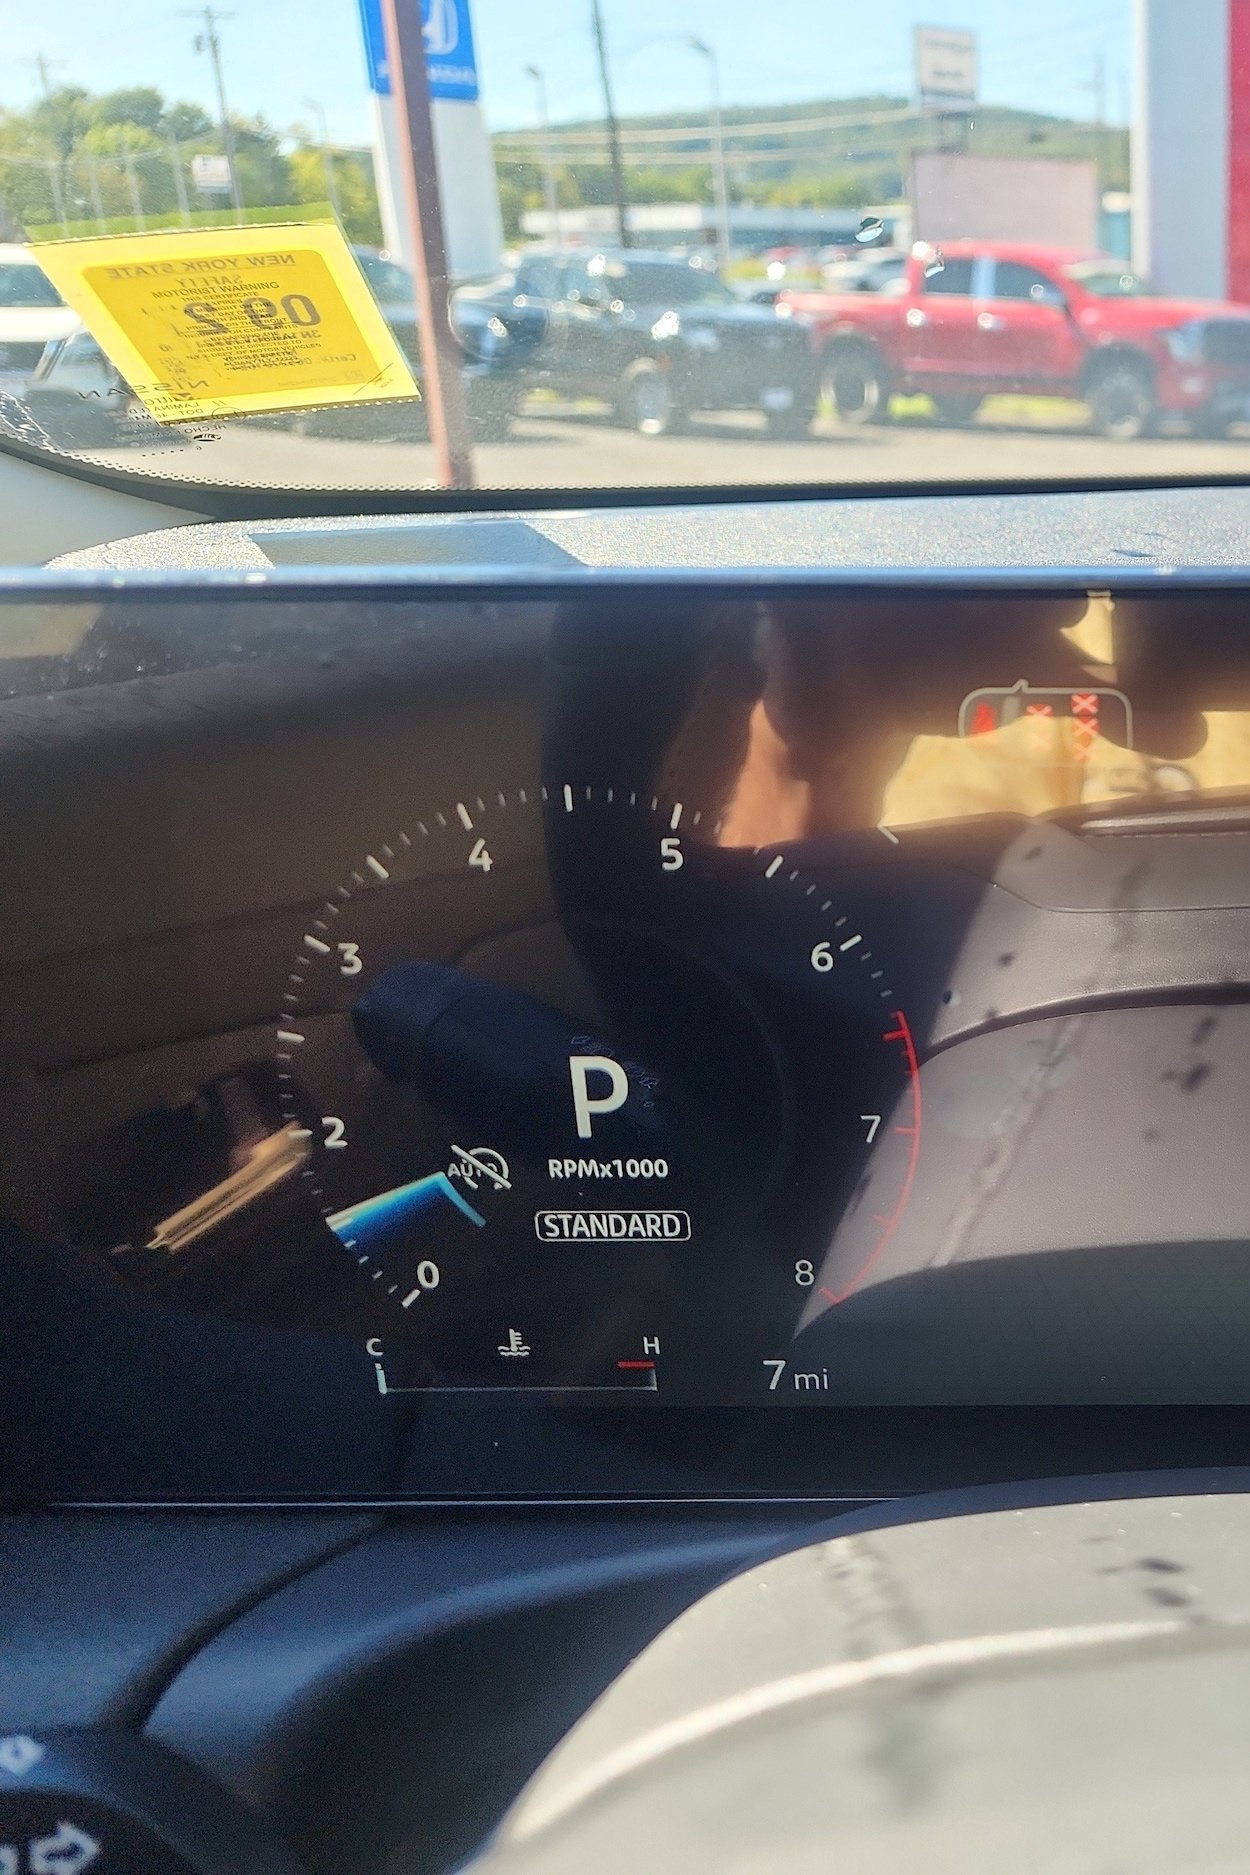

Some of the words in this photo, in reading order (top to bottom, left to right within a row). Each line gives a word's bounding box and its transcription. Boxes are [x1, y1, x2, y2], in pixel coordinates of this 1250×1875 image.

[151, 286, 218, 299] MOTORIST
[220, 281, 280, 293] WARNING
[468, 838, 493, 872] 4
[660, 838, 684, 871] 5
[337, 942, 363, 976] 3
[810, 941, 834, 973] 6
[569, 1055, 629, 1139] P
[321, 1116, 348, 1149] 2
[860, 1114, 882, 1144] 7
[447, 1162, 499, 1178] AUO
[547, 1158, 669, 1181] RPMx1000
[544, 1212, 682, 1239] STANDARD
[417, 1260, 441, 1290] 0
[794, 1259, 816, 1286] 8
[365, 1337, 384, 1357] C
[643, 1336, 661, 1355] H
[762, 1359, 787, 1390] 7
[794, 1367, 829, 1390] mi
